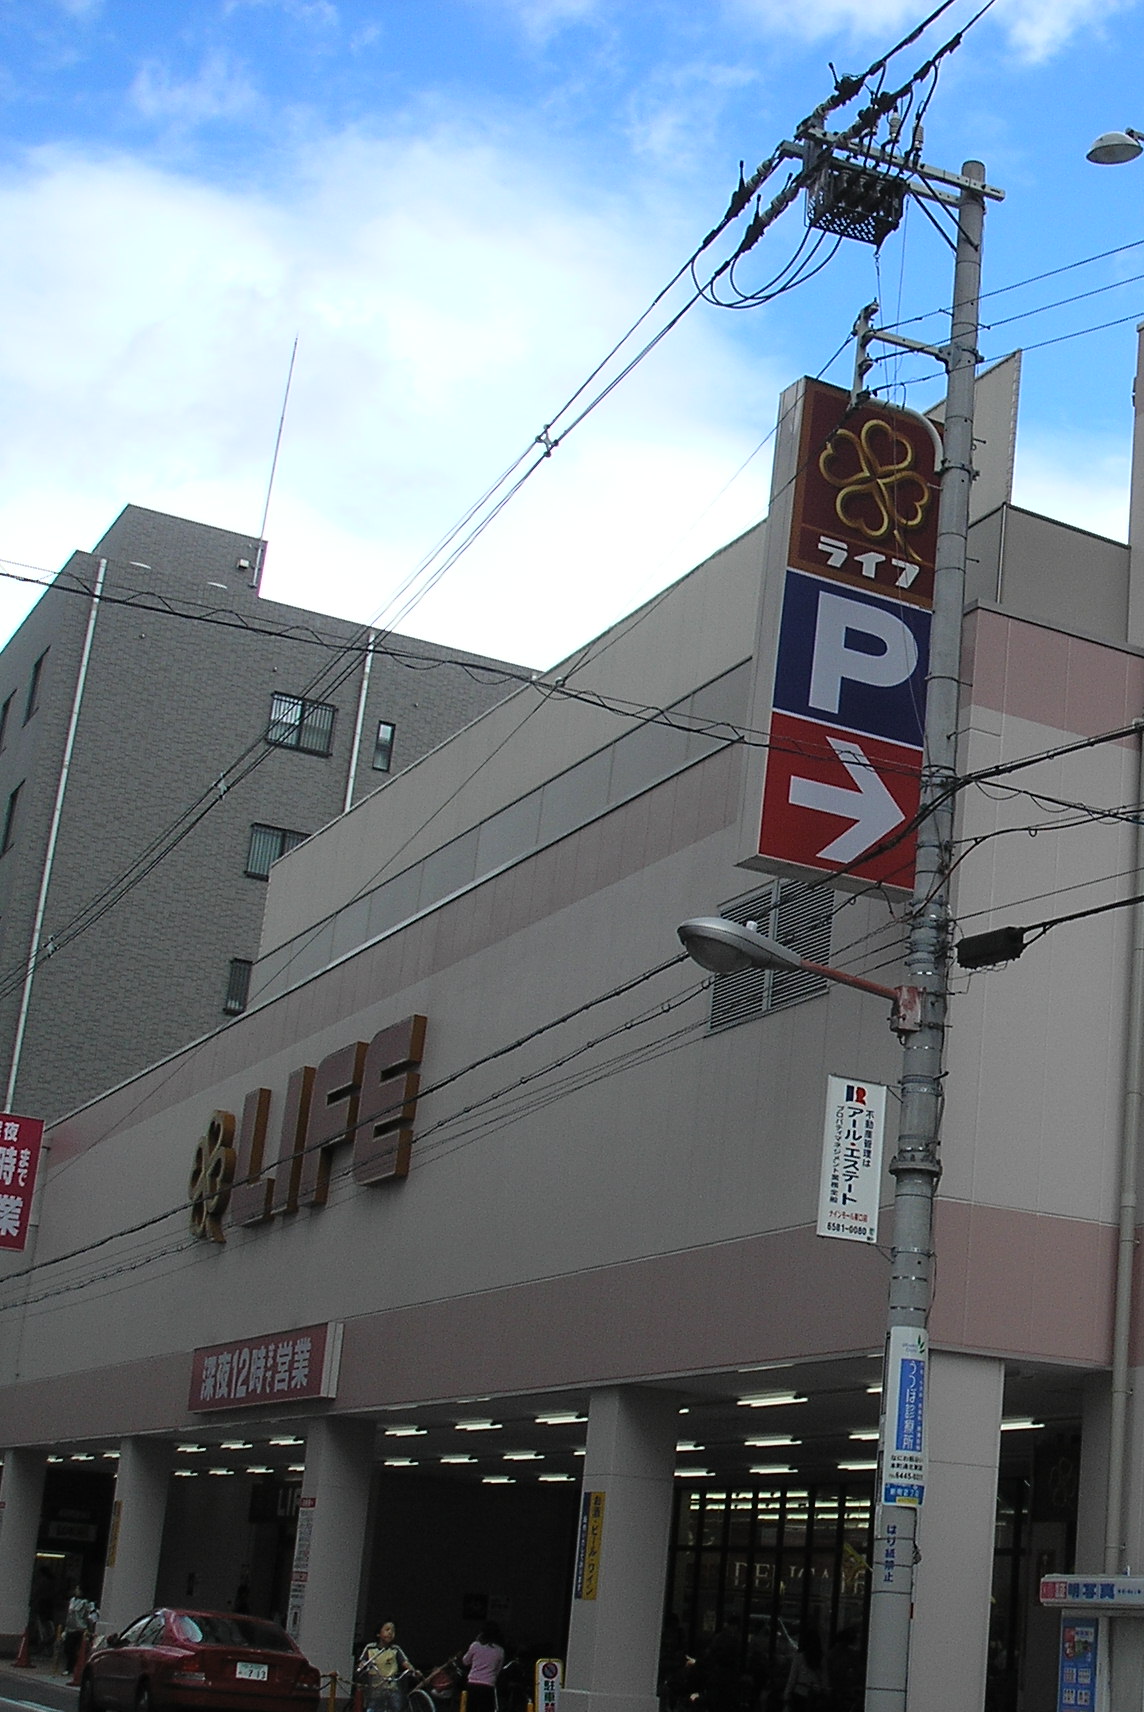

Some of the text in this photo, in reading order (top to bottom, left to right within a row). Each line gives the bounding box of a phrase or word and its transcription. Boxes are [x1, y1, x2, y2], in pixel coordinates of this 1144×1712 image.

[818, 536, 919, 589] ライフ
[808, 590, 919, 715] P
[0, 1121, 20, 1142] 夜
[231, 1014, 427, 1228] LIFE
[842, 1106, 864, 1206] アール・エステート
[883, 1524, 897, 1583] はり紙禁止
